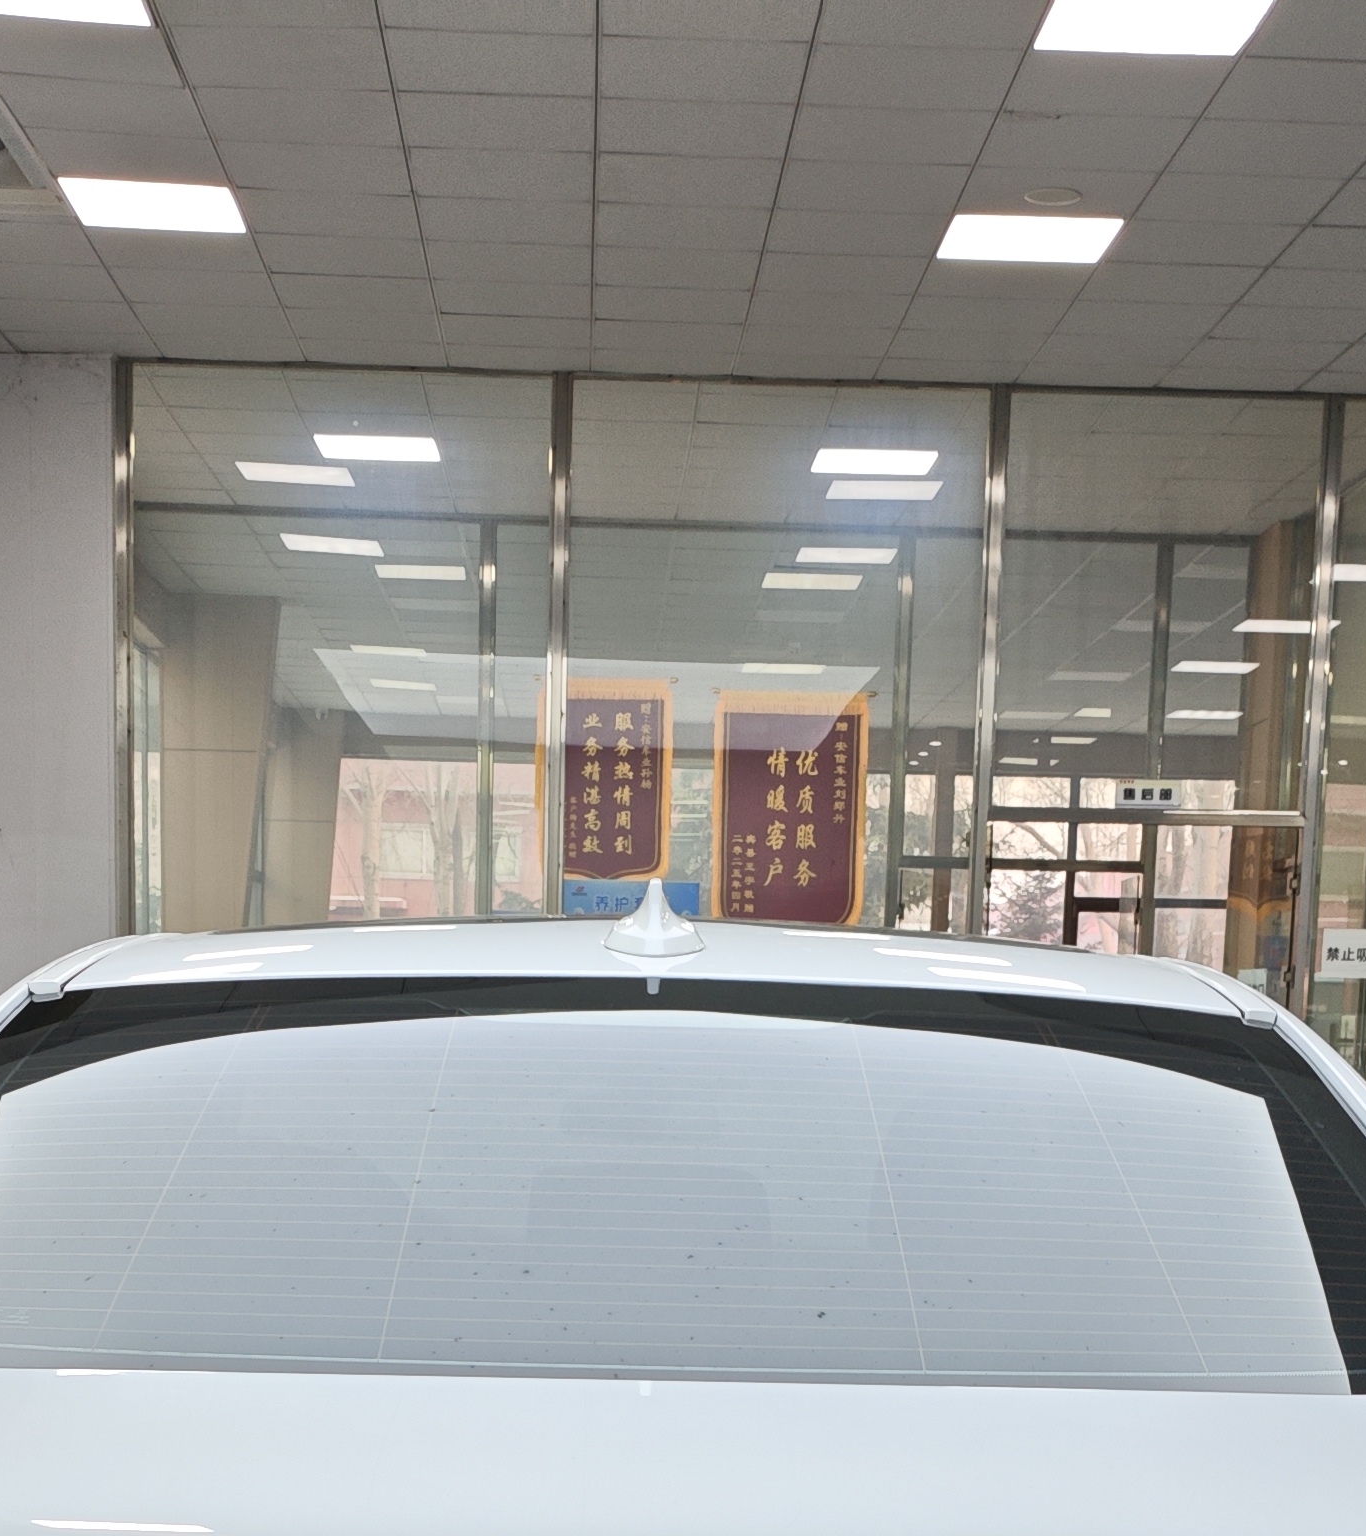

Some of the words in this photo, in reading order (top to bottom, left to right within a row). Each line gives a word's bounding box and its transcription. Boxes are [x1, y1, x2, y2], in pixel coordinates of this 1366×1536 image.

[581, 712, 603, 854] 业务精湛高效
[613, 711, 635, 855] 服务热情周到
[764, 746, 789, 888] 情暖客户
[793, 749, 819, 888] 优质服务
